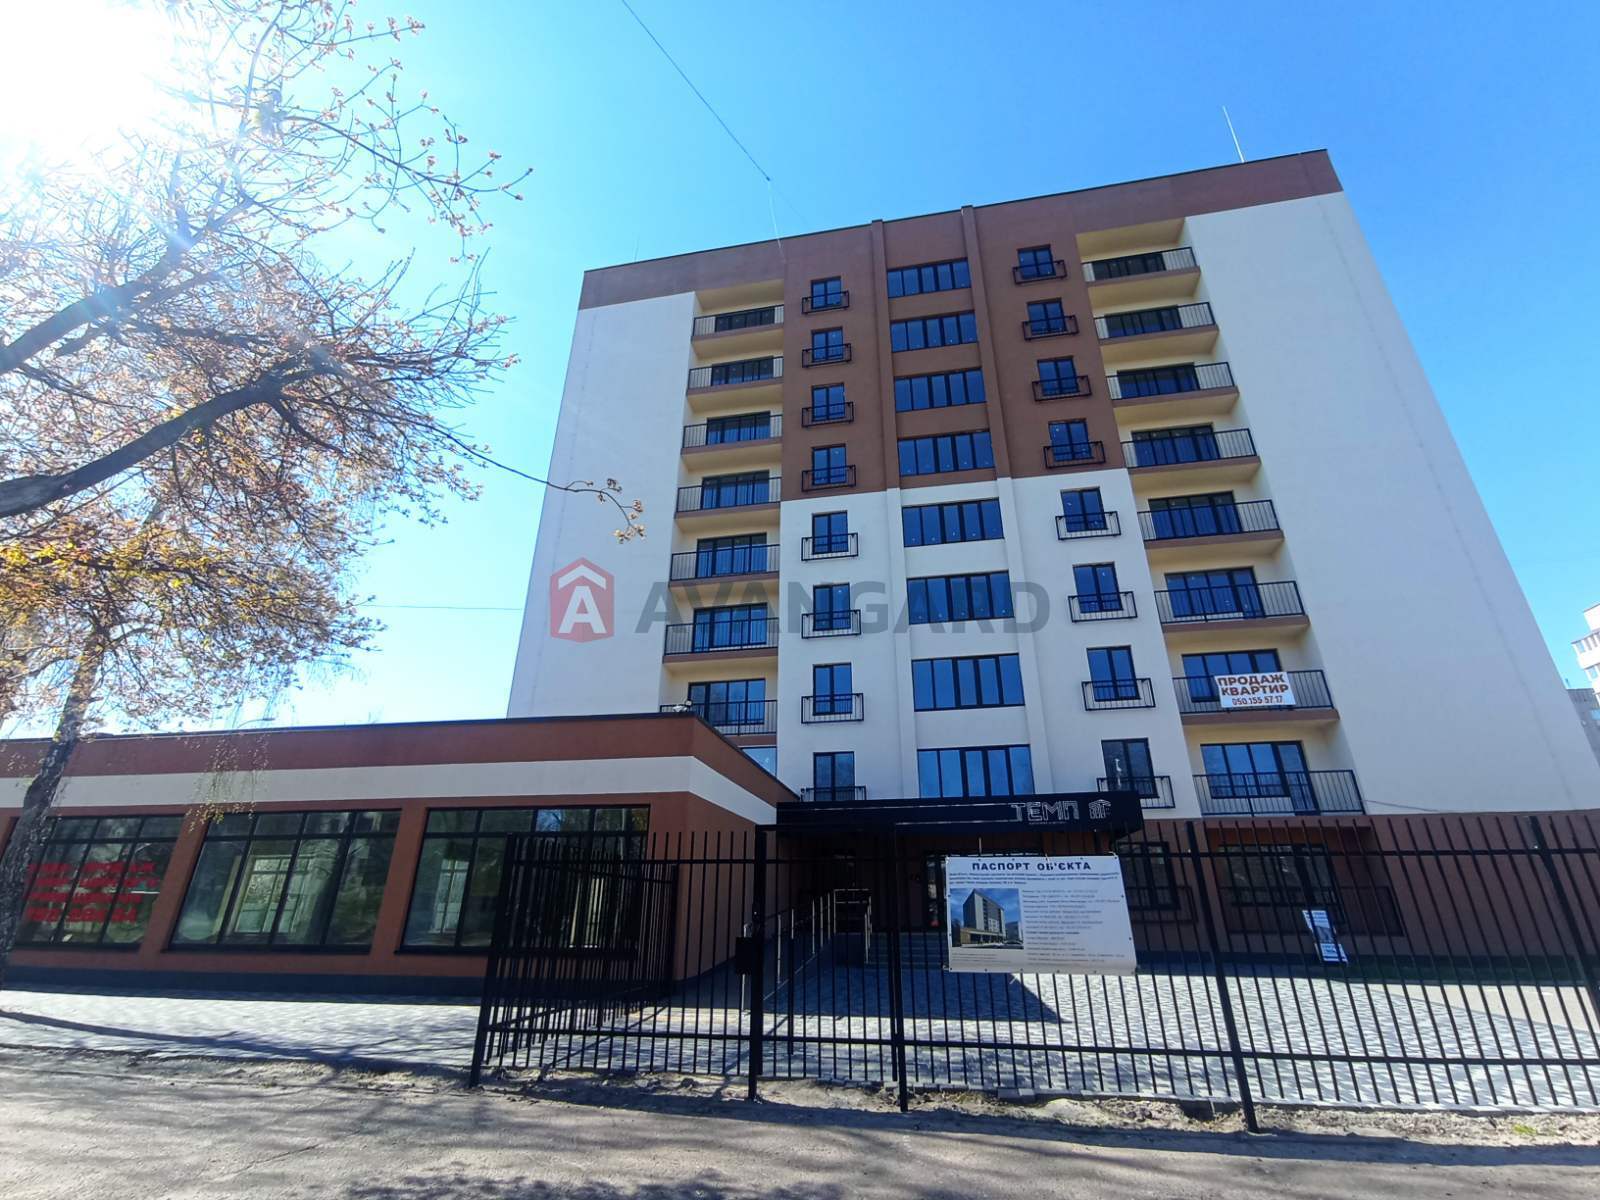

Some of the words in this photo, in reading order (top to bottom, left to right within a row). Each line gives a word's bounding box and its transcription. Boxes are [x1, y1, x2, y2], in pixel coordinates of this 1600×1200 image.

[1217, 674, 1286, 686] ПРОДАЖ
[1221, 684, 1289, 696] КВАРТИР
[1232, 697, 1248, 706] 050
[1249, 696, 1263, 705] 155
[1010, 800, 1080, 822] ТЕМП
[972, 862, 1031, 871] ПАСПОРТ
